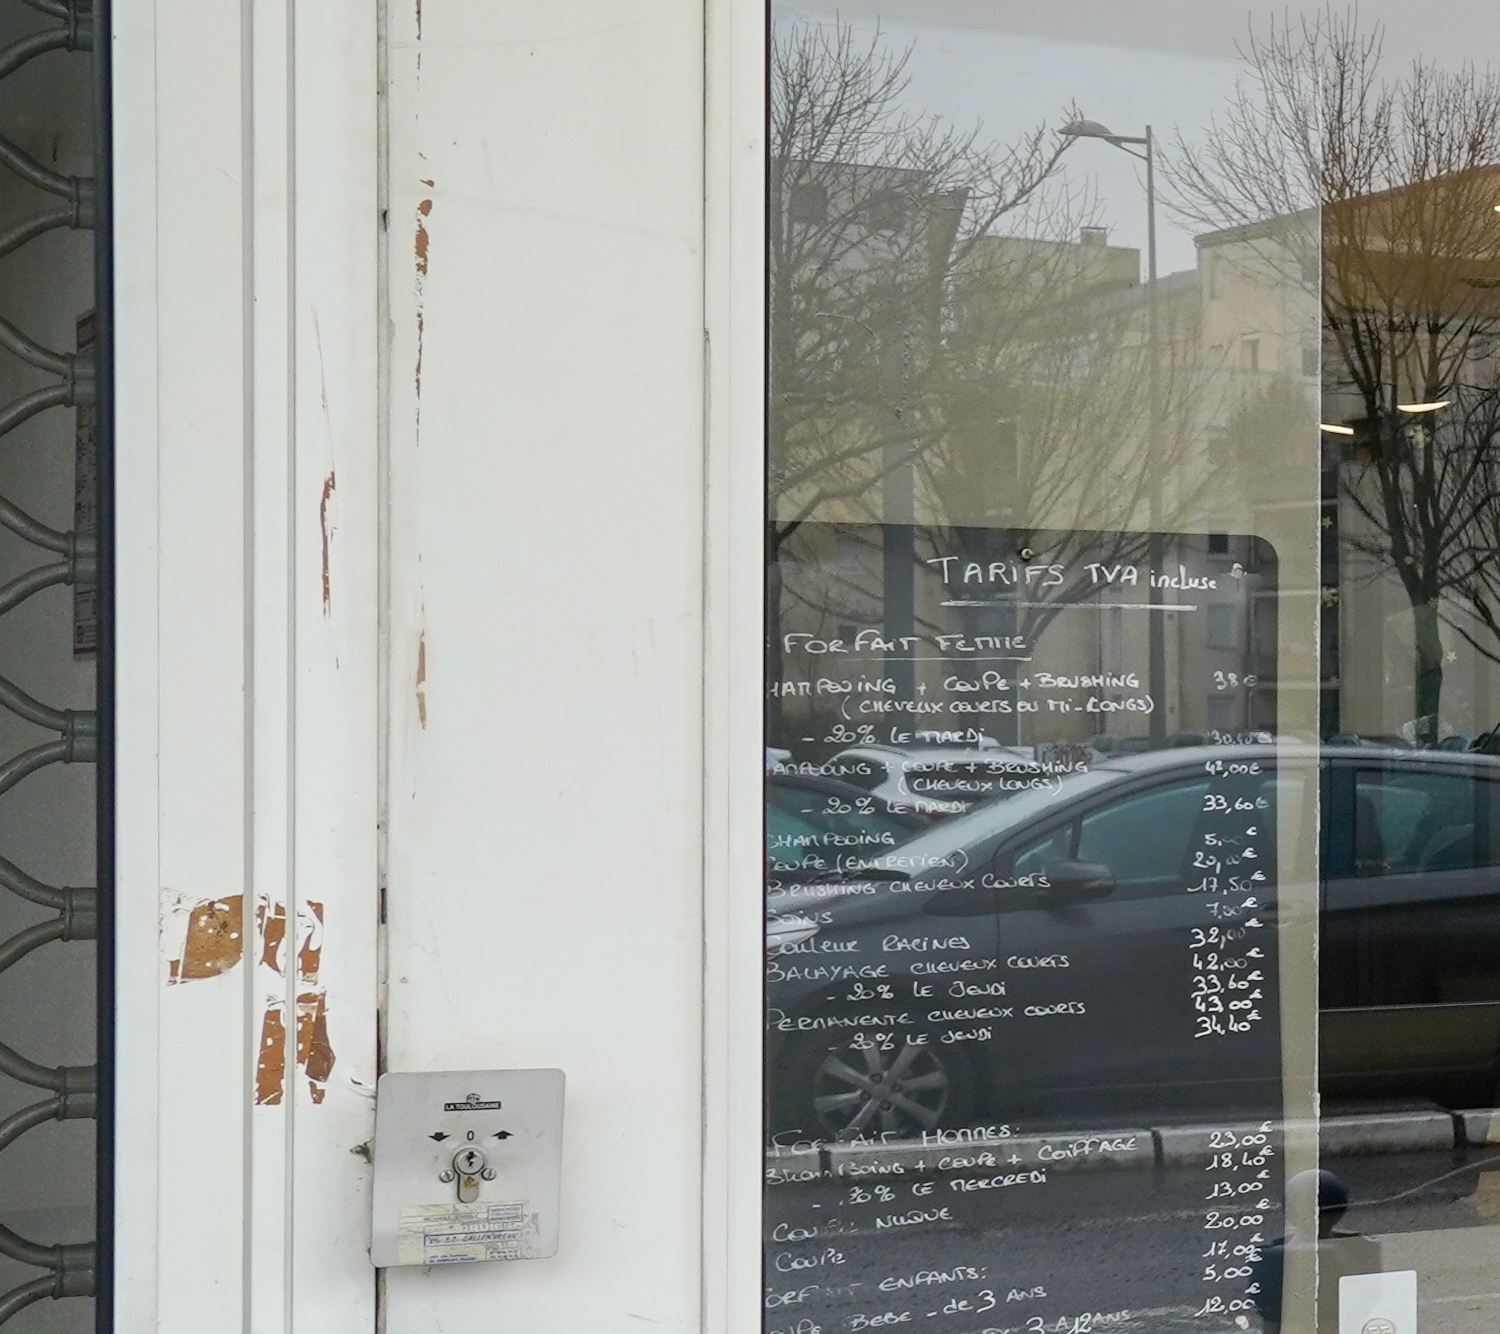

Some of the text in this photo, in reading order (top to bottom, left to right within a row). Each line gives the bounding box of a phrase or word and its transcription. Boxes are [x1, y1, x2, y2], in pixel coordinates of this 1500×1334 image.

[1087, 564, 1137, 586] TVA
[1036, 671, 1139, 689] BRUSHING
[913, 981, 934, 997] LE
[907, 1029, 928, 1045] LE
[976, 1291, 996, 1313] 3
